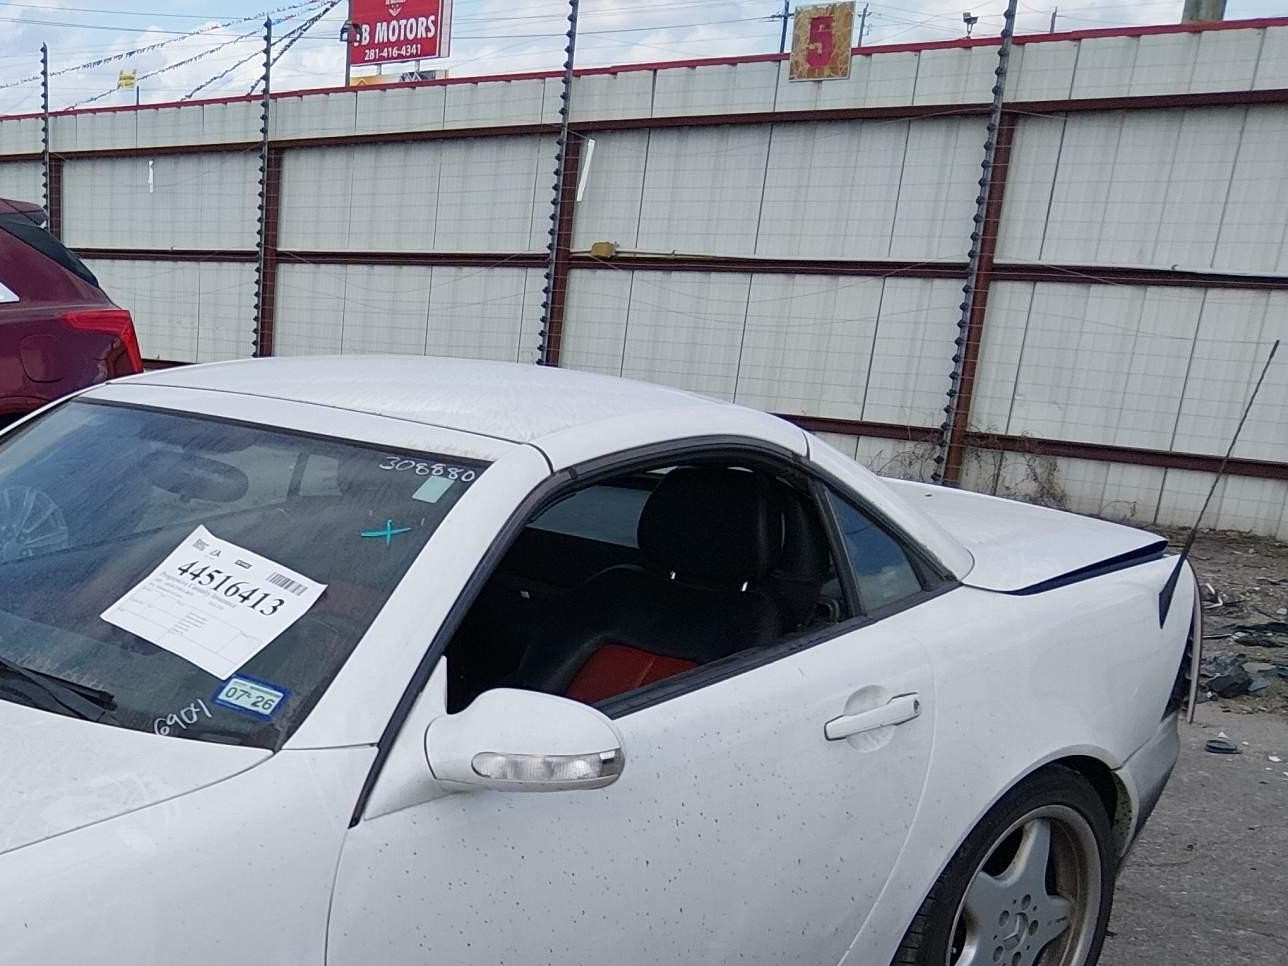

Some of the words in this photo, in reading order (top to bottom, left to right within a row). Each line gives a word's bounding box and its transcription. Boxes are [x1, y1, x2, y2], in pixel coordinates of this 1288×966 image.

[374, 15, 436, 44] MOTORS
[807, 16, 835, 68] 5
[364, 43, 421, 61] 281-416-4341
[378, 456, 476, 482] 308880
[177, 560, 285, 616] 44516413
[225, 686, 248, 701] 07
[251, 695, 275, 712] 26
